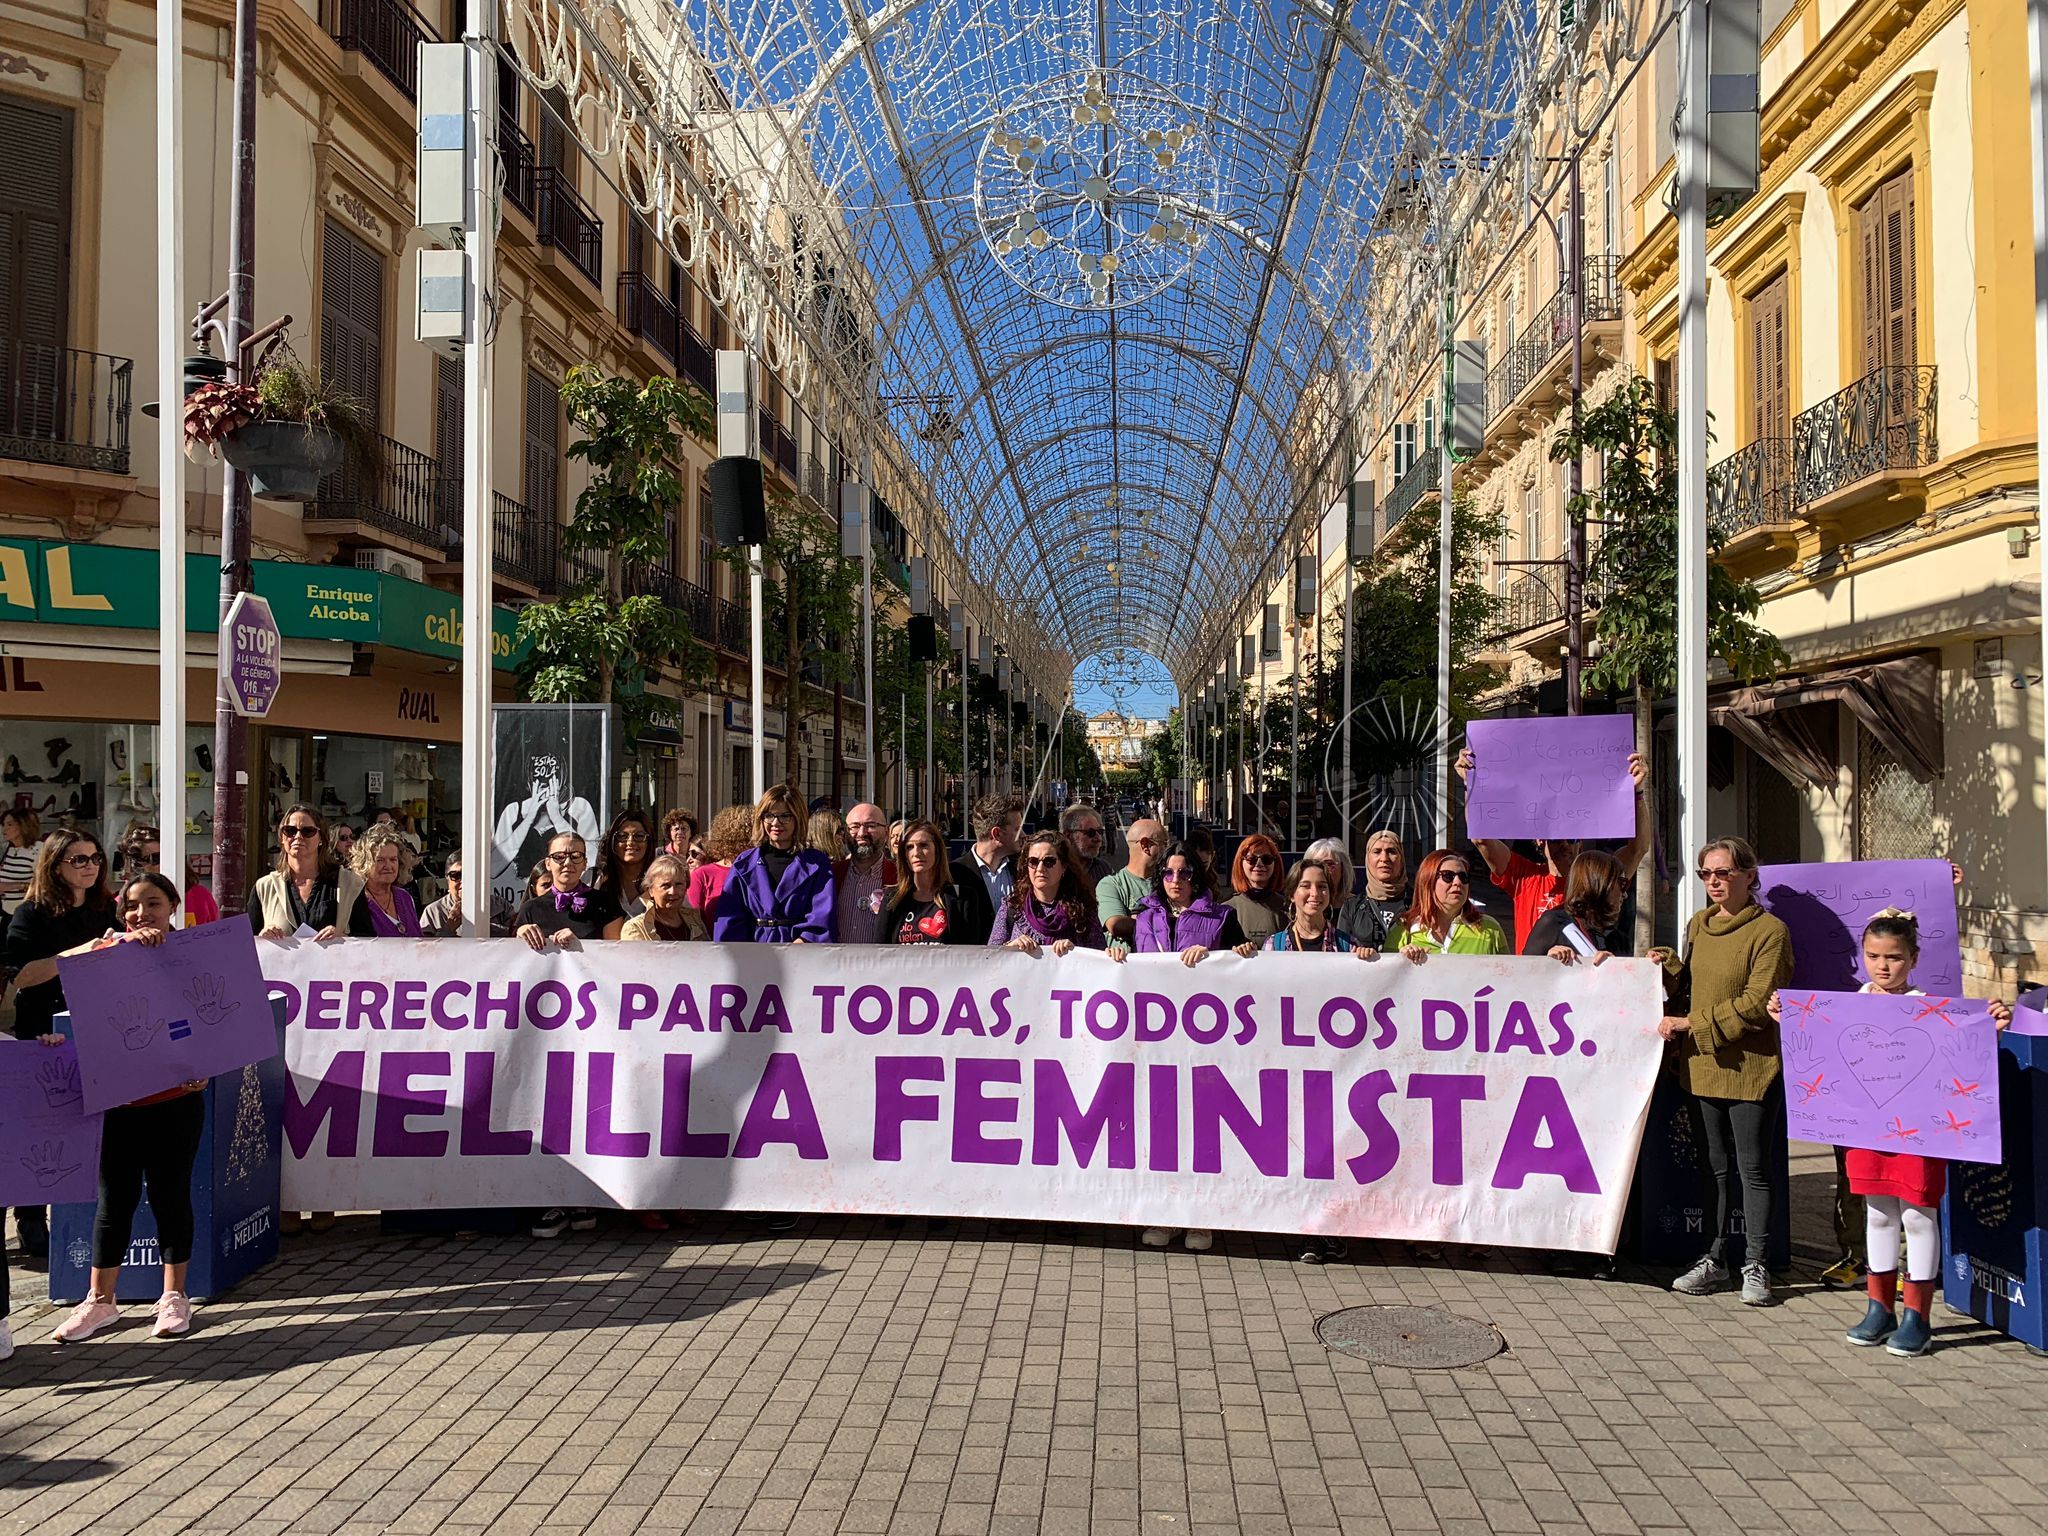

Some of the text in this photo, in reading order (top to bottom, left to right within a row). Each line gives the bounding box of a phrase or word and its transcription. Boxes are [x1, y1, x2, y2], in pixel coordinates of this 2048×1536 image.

[306, 584, 374, 604] Enrique
[308, 604, 370, 622] Alcoba
[237, 623, 276, 655] STOP
[424, 608, 510, 657] calzos
[236, 653, 275, 668] A LA VIOLENCIA
[241, 665, 271, 680] DE GÉNERO
[243, 680, 258, 694] 016
[397, 687, 440, 724] RUAL
[1539, 770, 1584, 794] NO
[617, 983, 793, 1033] PARA
[812, 984, 1031, 1045] TODAS,
[1050, 989, 1258, 1046] TODOS
[1280, 996, 1398, 1050] LOS
[1421, 984, 1598, 1057] DÍAS.
[284, 1050, 1602, 1195] MELILLA FEMINISTA
[1683, 1207, 1703, 1216] CIUD
[131, 1236, 159, 1247] AUTÓ
[233, 1215, 271, 1250] MELILLA
[1971, 1266, 2026, 1307] MELILLA
